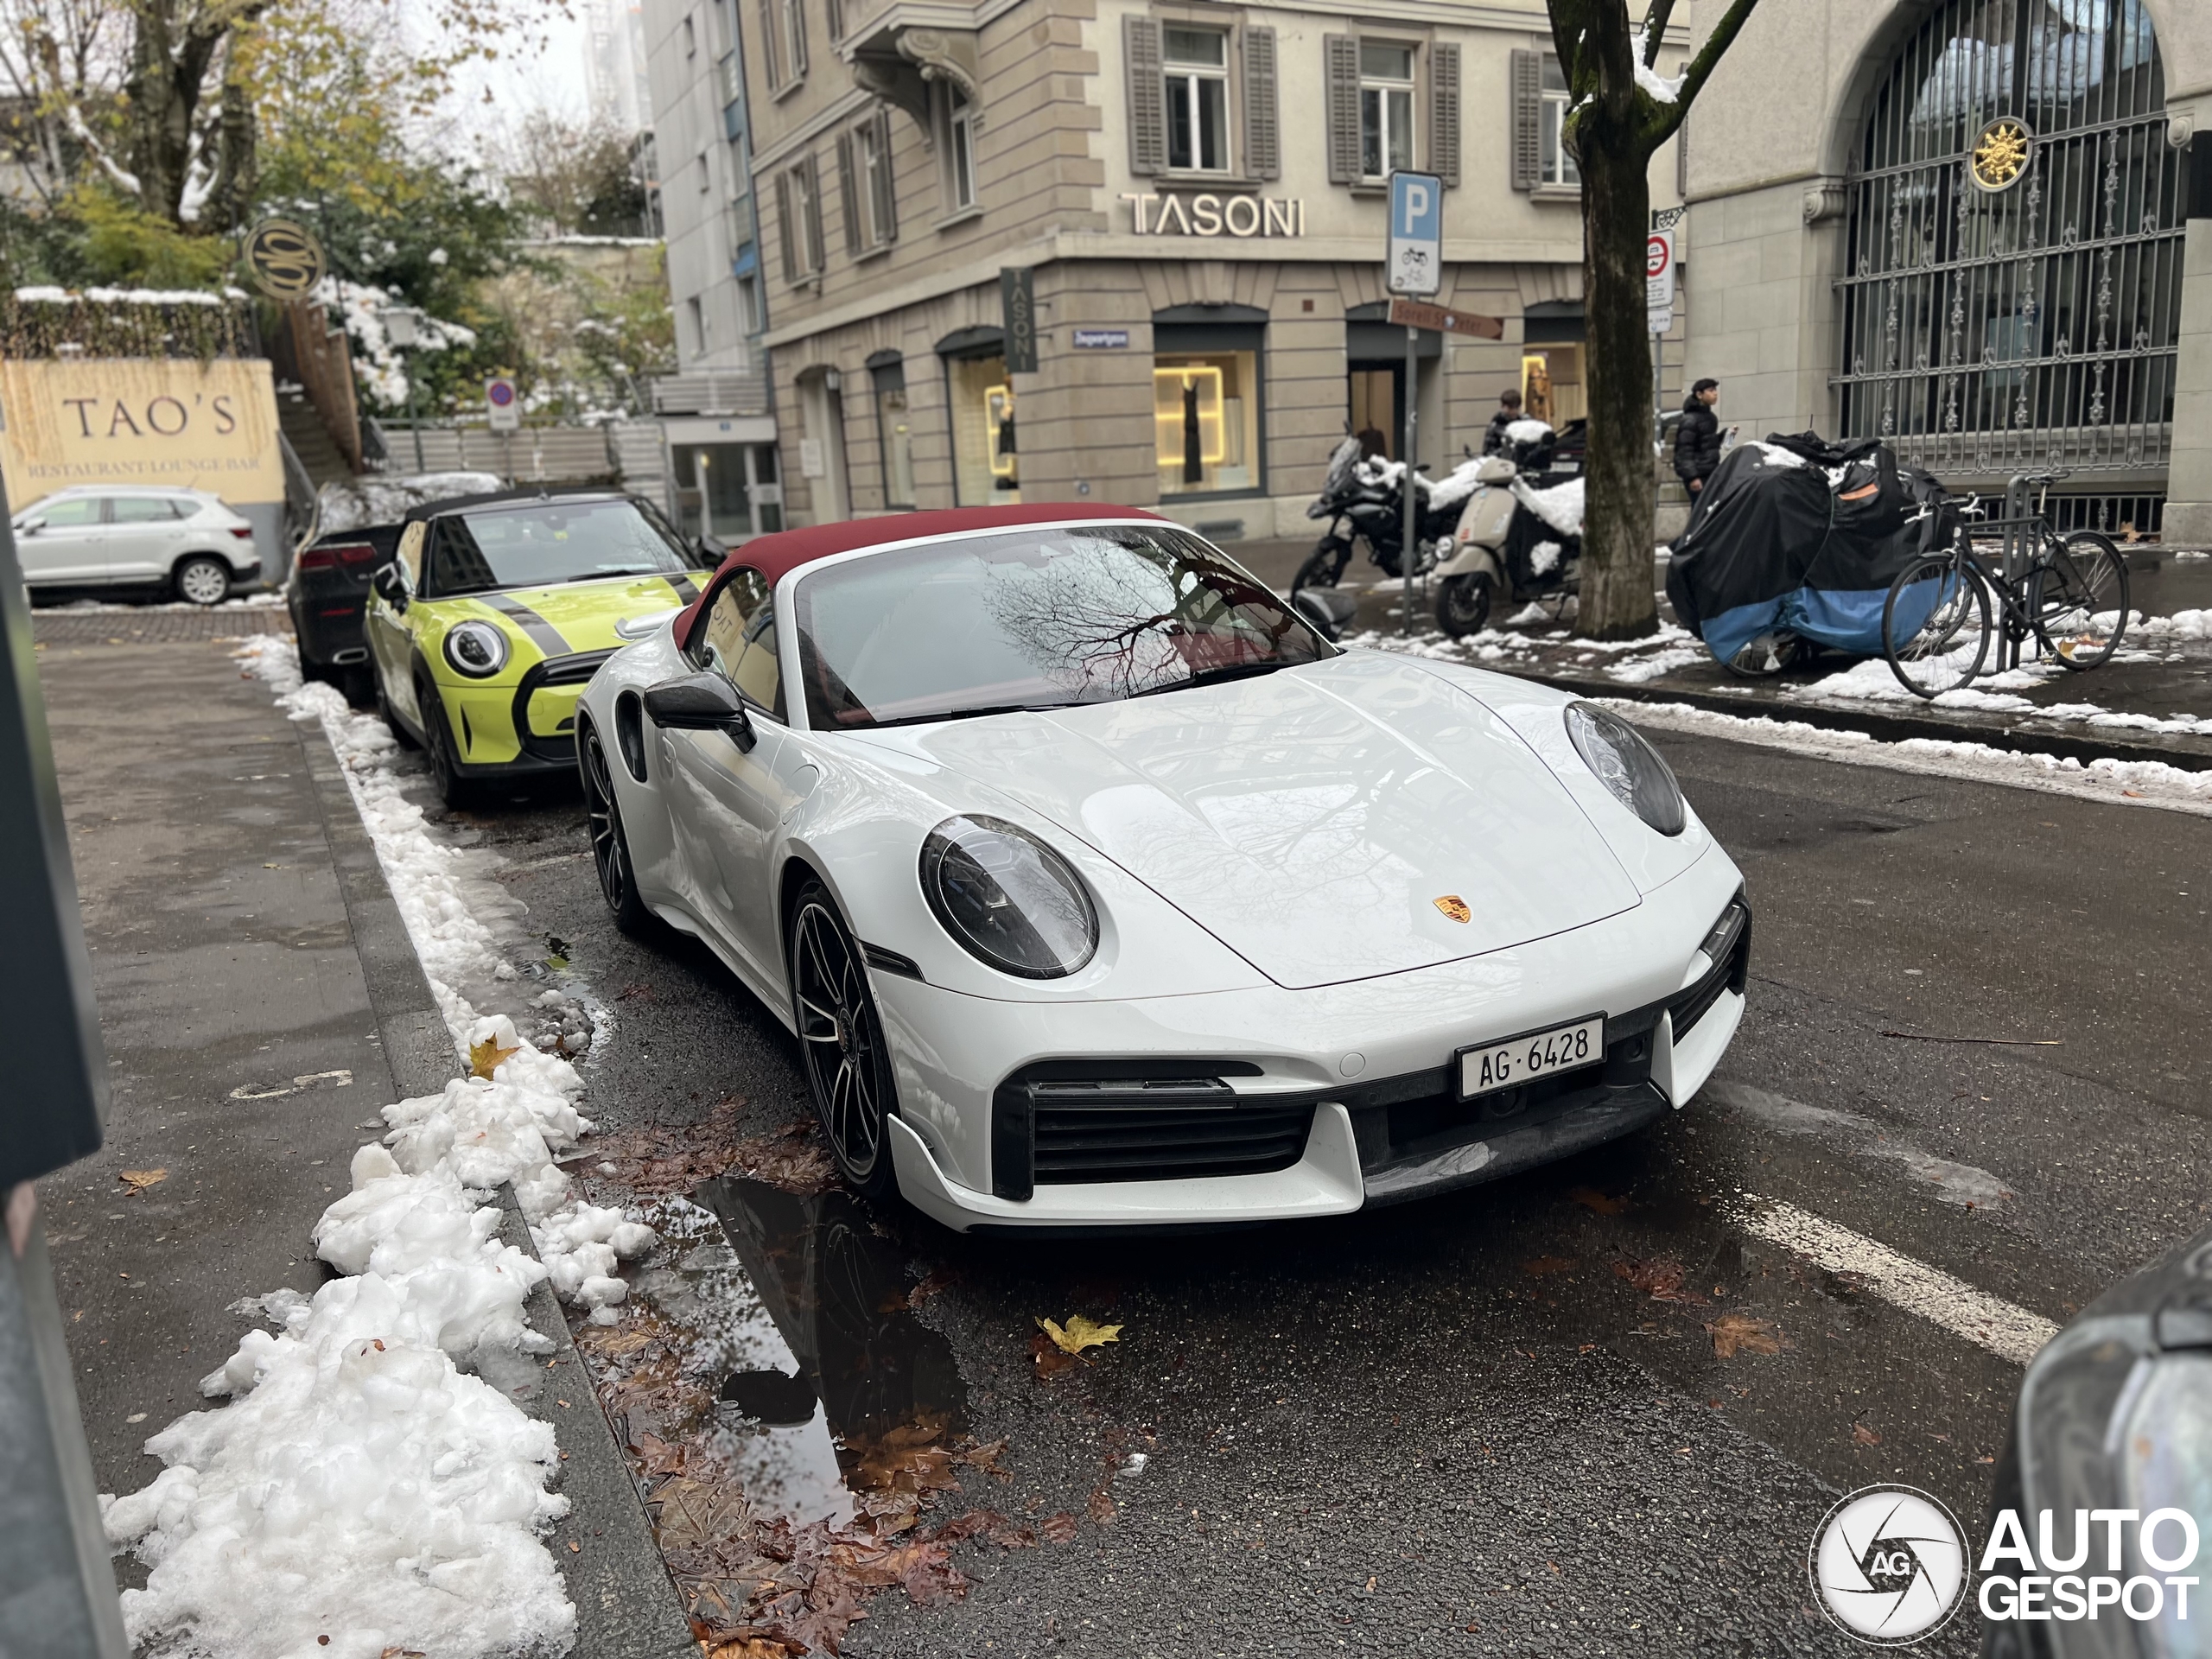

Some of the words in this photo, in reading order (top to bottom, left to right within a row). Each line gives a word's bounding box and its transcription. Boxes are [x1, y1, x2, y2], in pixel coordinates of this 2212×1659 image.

[1121, 193, 1305, 237] TASONI
[1405, 183, 1428, 234] P
[1009, 266, 1030, 372] TASONI
[62, 392, 236, 438] TAO'S
[28, 460, 145, 480] RESTAURANT
[150, 457, 221, 474] LOUNGE
[226, 456, 260, 472] BAR
[1479, 1050, 1510, 1088] AG
[1528, 1028, 1588, 1072] 6428
